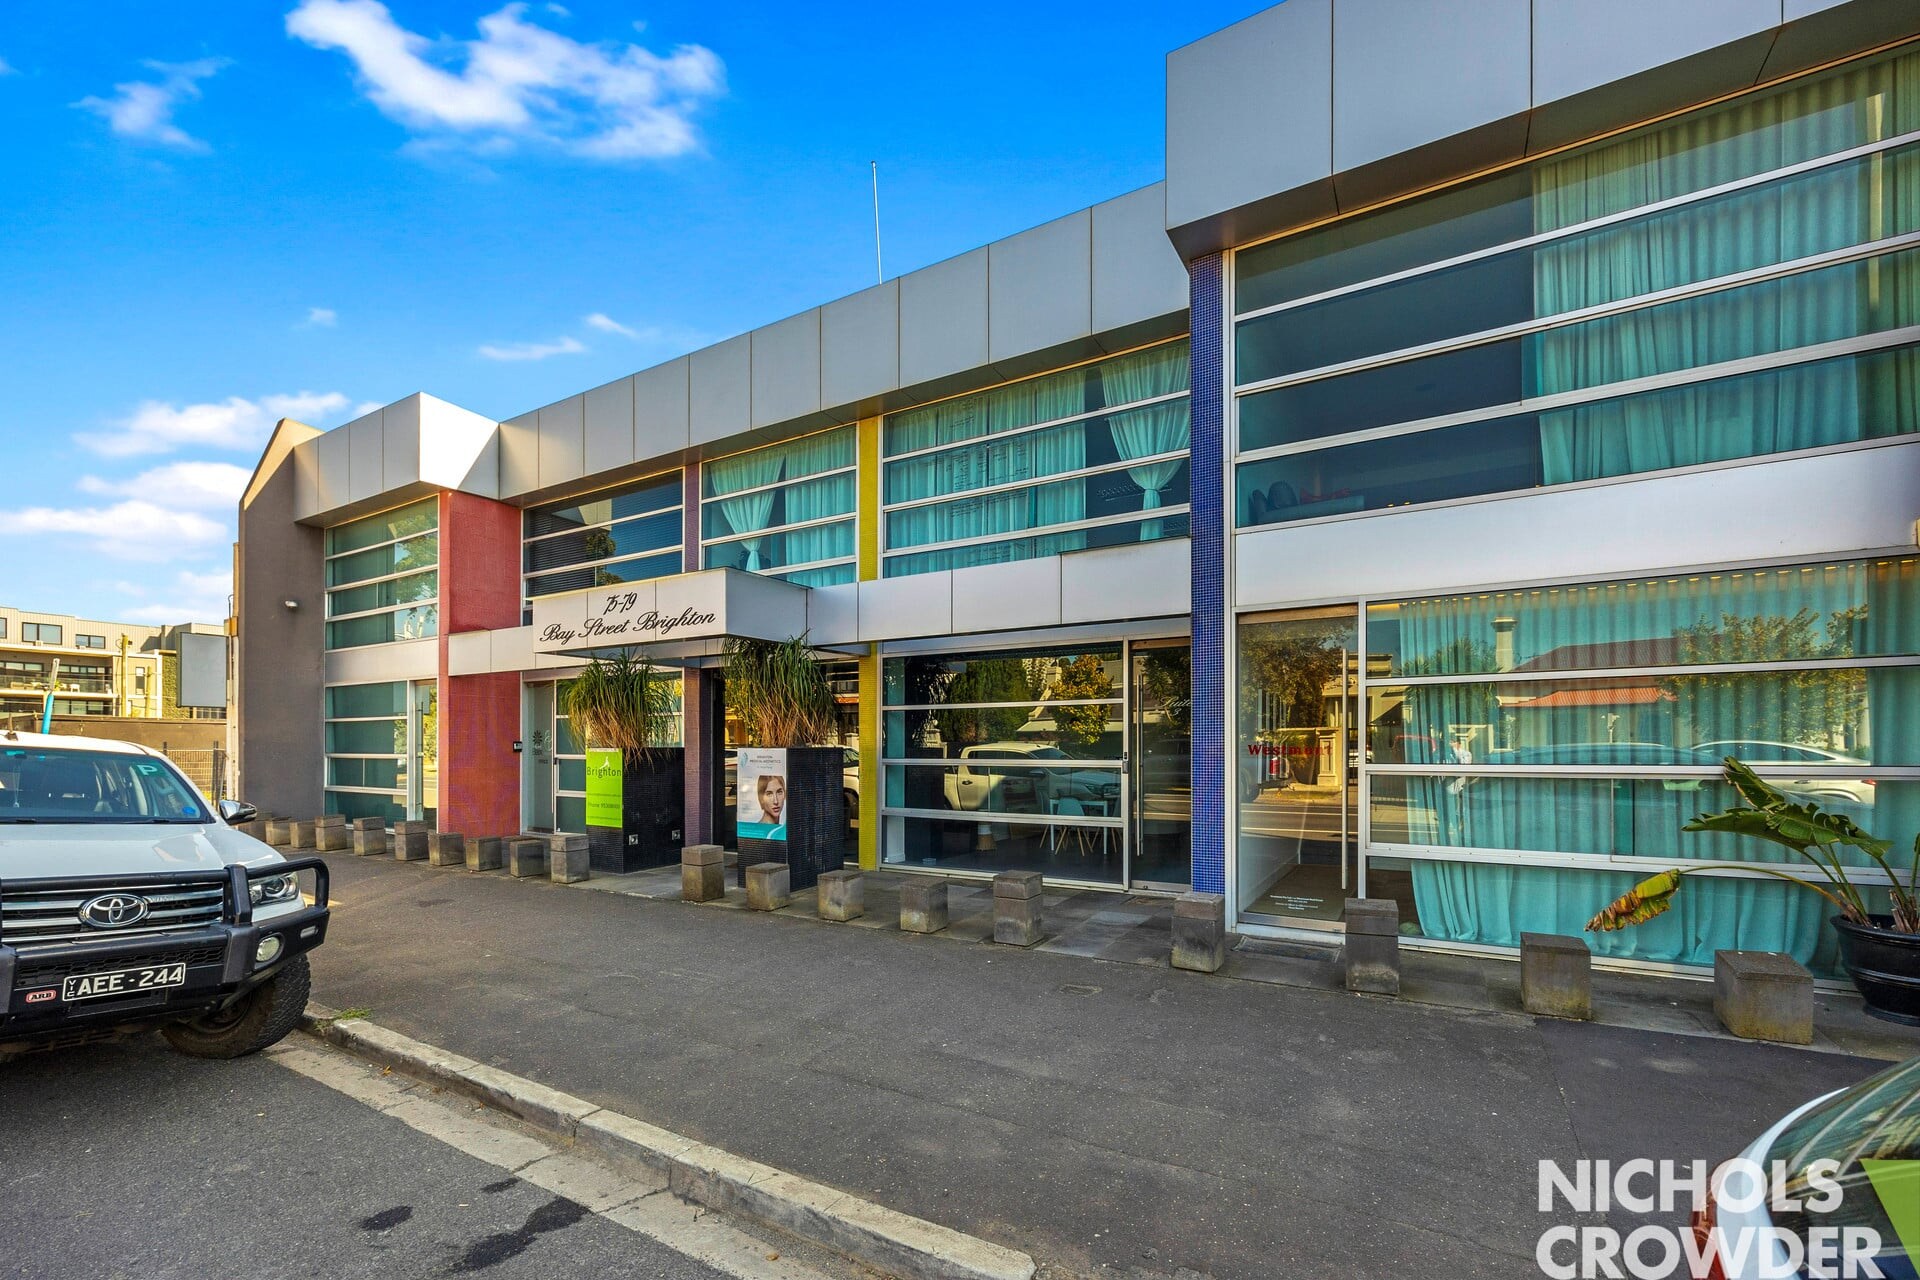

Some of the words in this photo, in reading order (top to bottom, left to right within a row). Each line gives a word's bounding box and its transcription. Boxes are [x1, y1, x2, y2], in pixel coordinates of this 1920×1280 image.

[603, 592, 637, 615] 75-79
[539, 623, 575, 645] Bay
[577, 617, 630, 638] Street
[632, 606, 716, 635] Brighton
[136, 764, 158, 776] P
[586, 766, 622, 779] Brighton
[30, 991, 52, 1001] ARB
